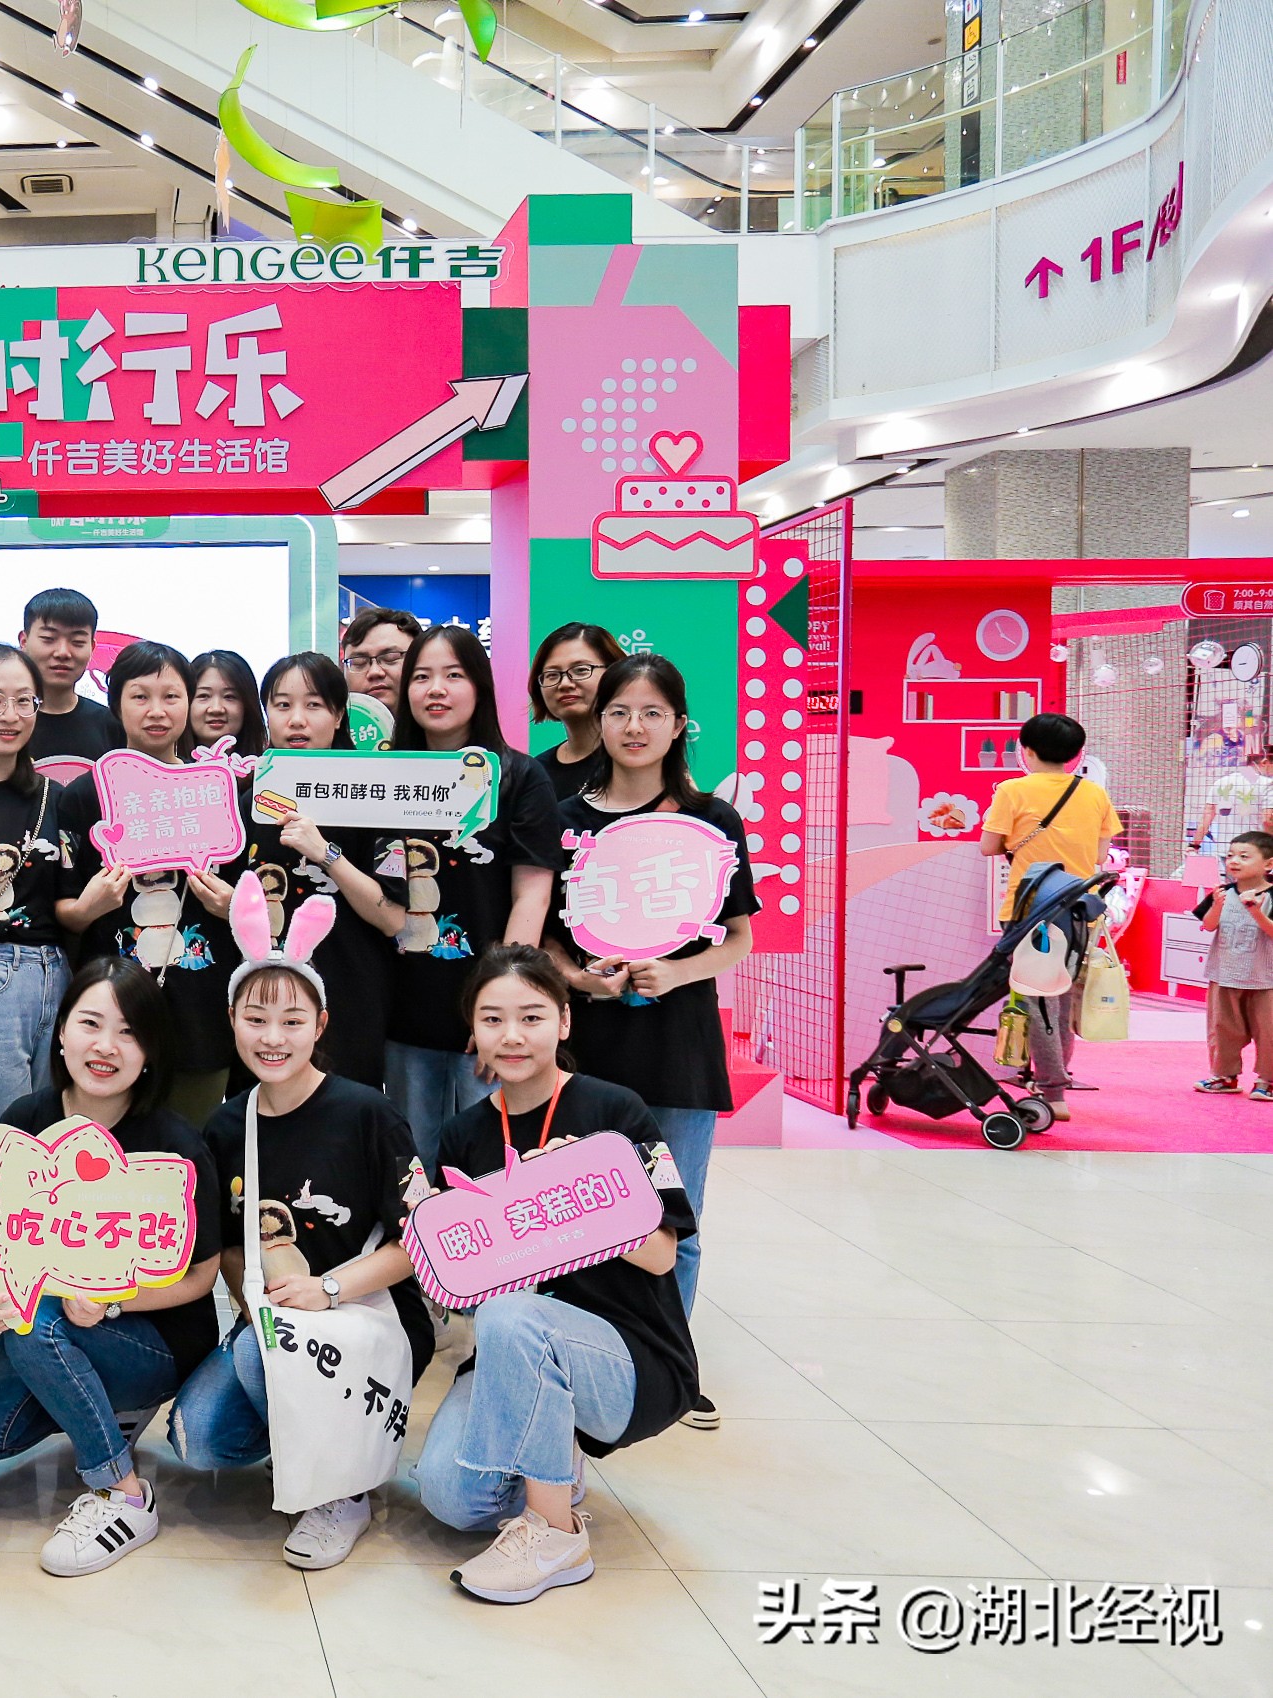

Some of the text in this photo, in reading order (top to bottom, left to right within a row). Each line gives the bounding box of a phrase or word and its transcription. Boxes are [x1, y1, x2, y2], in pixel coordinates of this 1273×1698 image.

[373, 244, 506, 280] 仟吉
[123, 783, 223, 816] 亲亲抱抱
[294, 782, 450, 802] 面包和酵母 我和你
[127, 812, 201, 841] 举高高
[6, 1208, 177, 1250] 吃心不改
[557, 1229, 586, 1245] 仟吉
